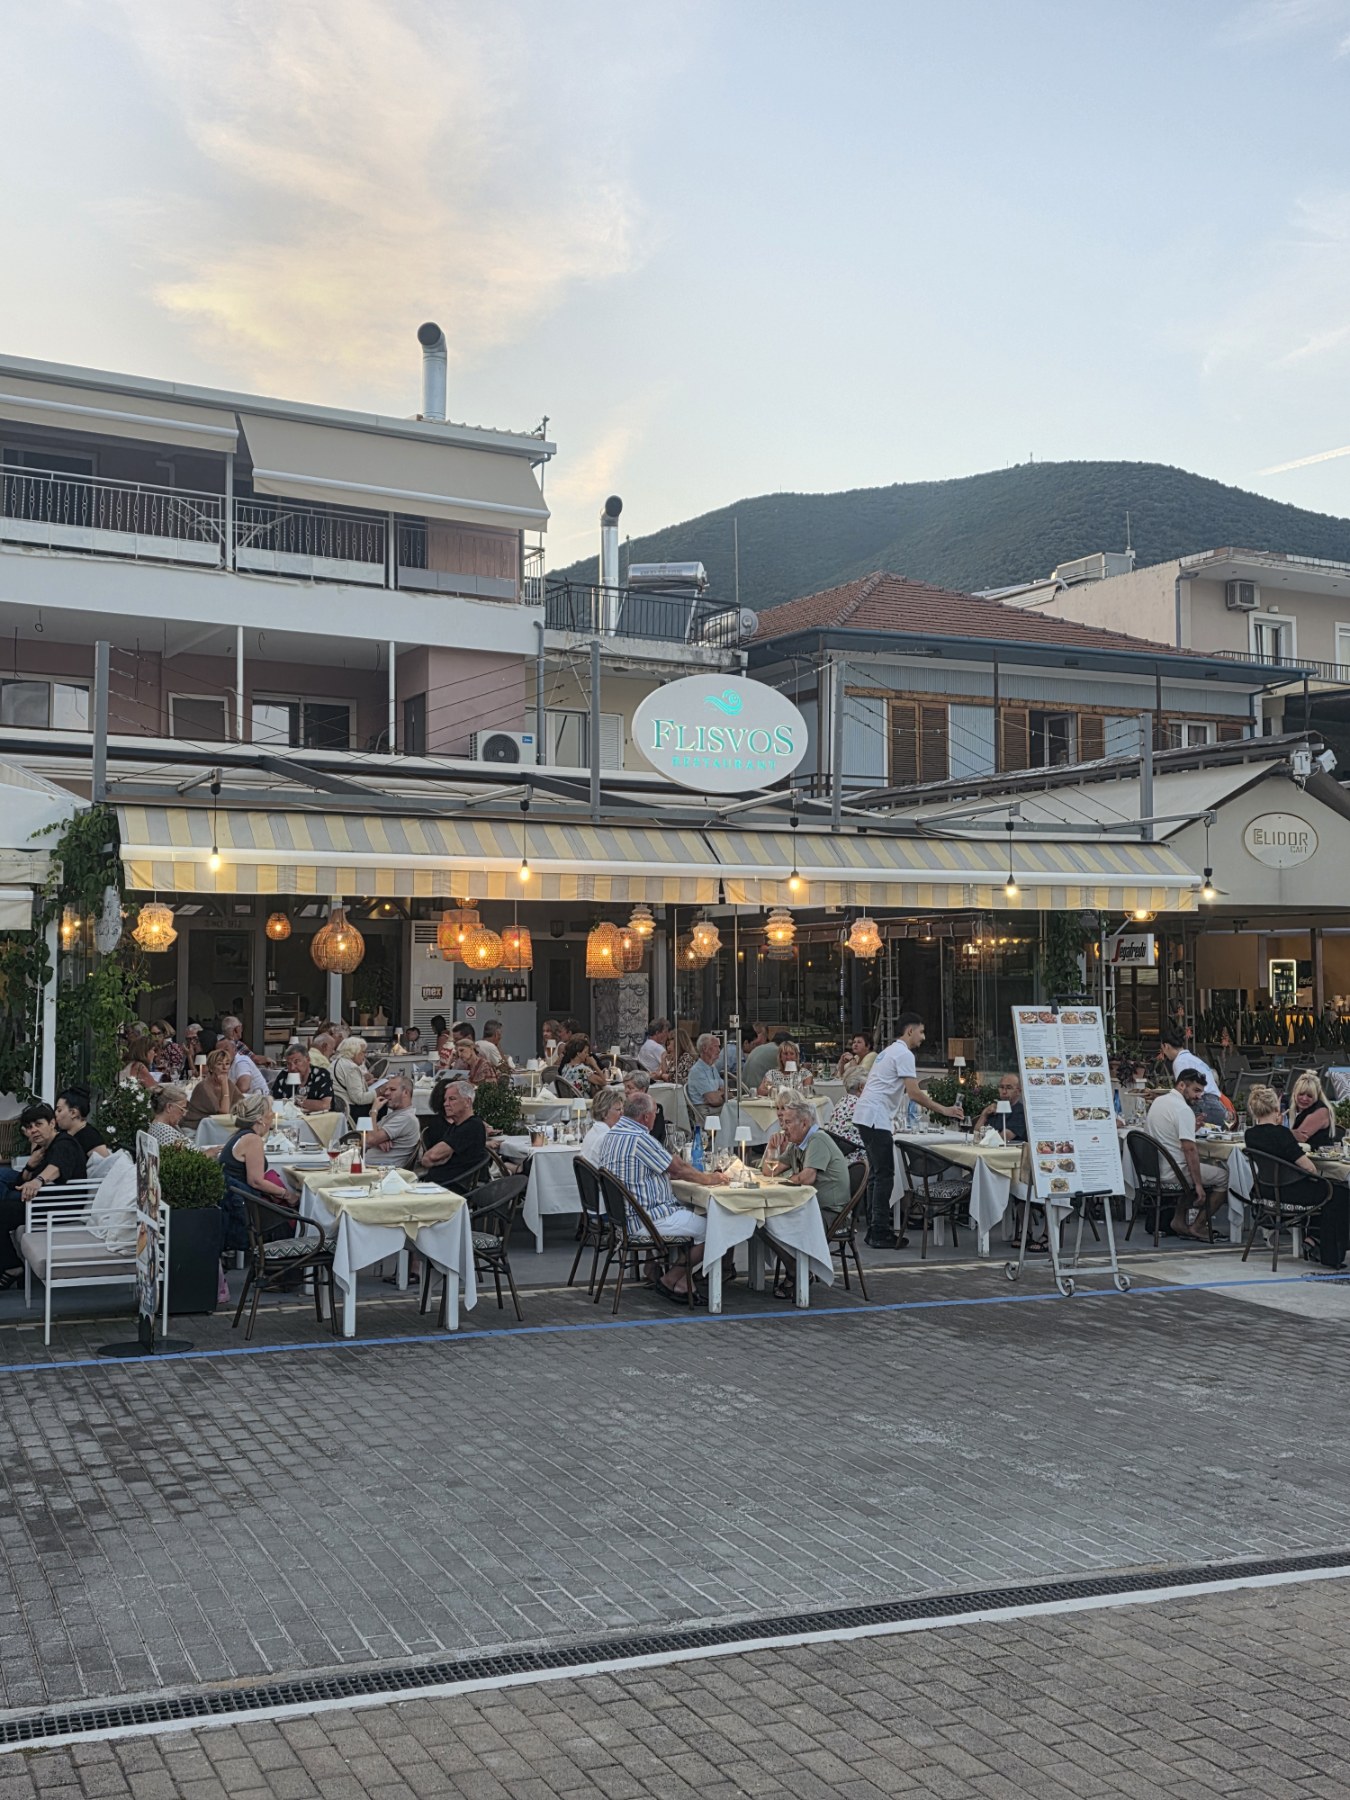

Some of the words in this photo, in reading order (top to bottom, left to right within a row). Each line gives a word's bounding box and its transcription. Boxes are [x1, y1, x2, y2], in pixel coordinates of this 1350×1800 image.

[651, 719, 794, 756] FLISVOS
[672, 755, 776, 770] RESTAURANT
[1253, 828, 1308, 846] ELIDOR
